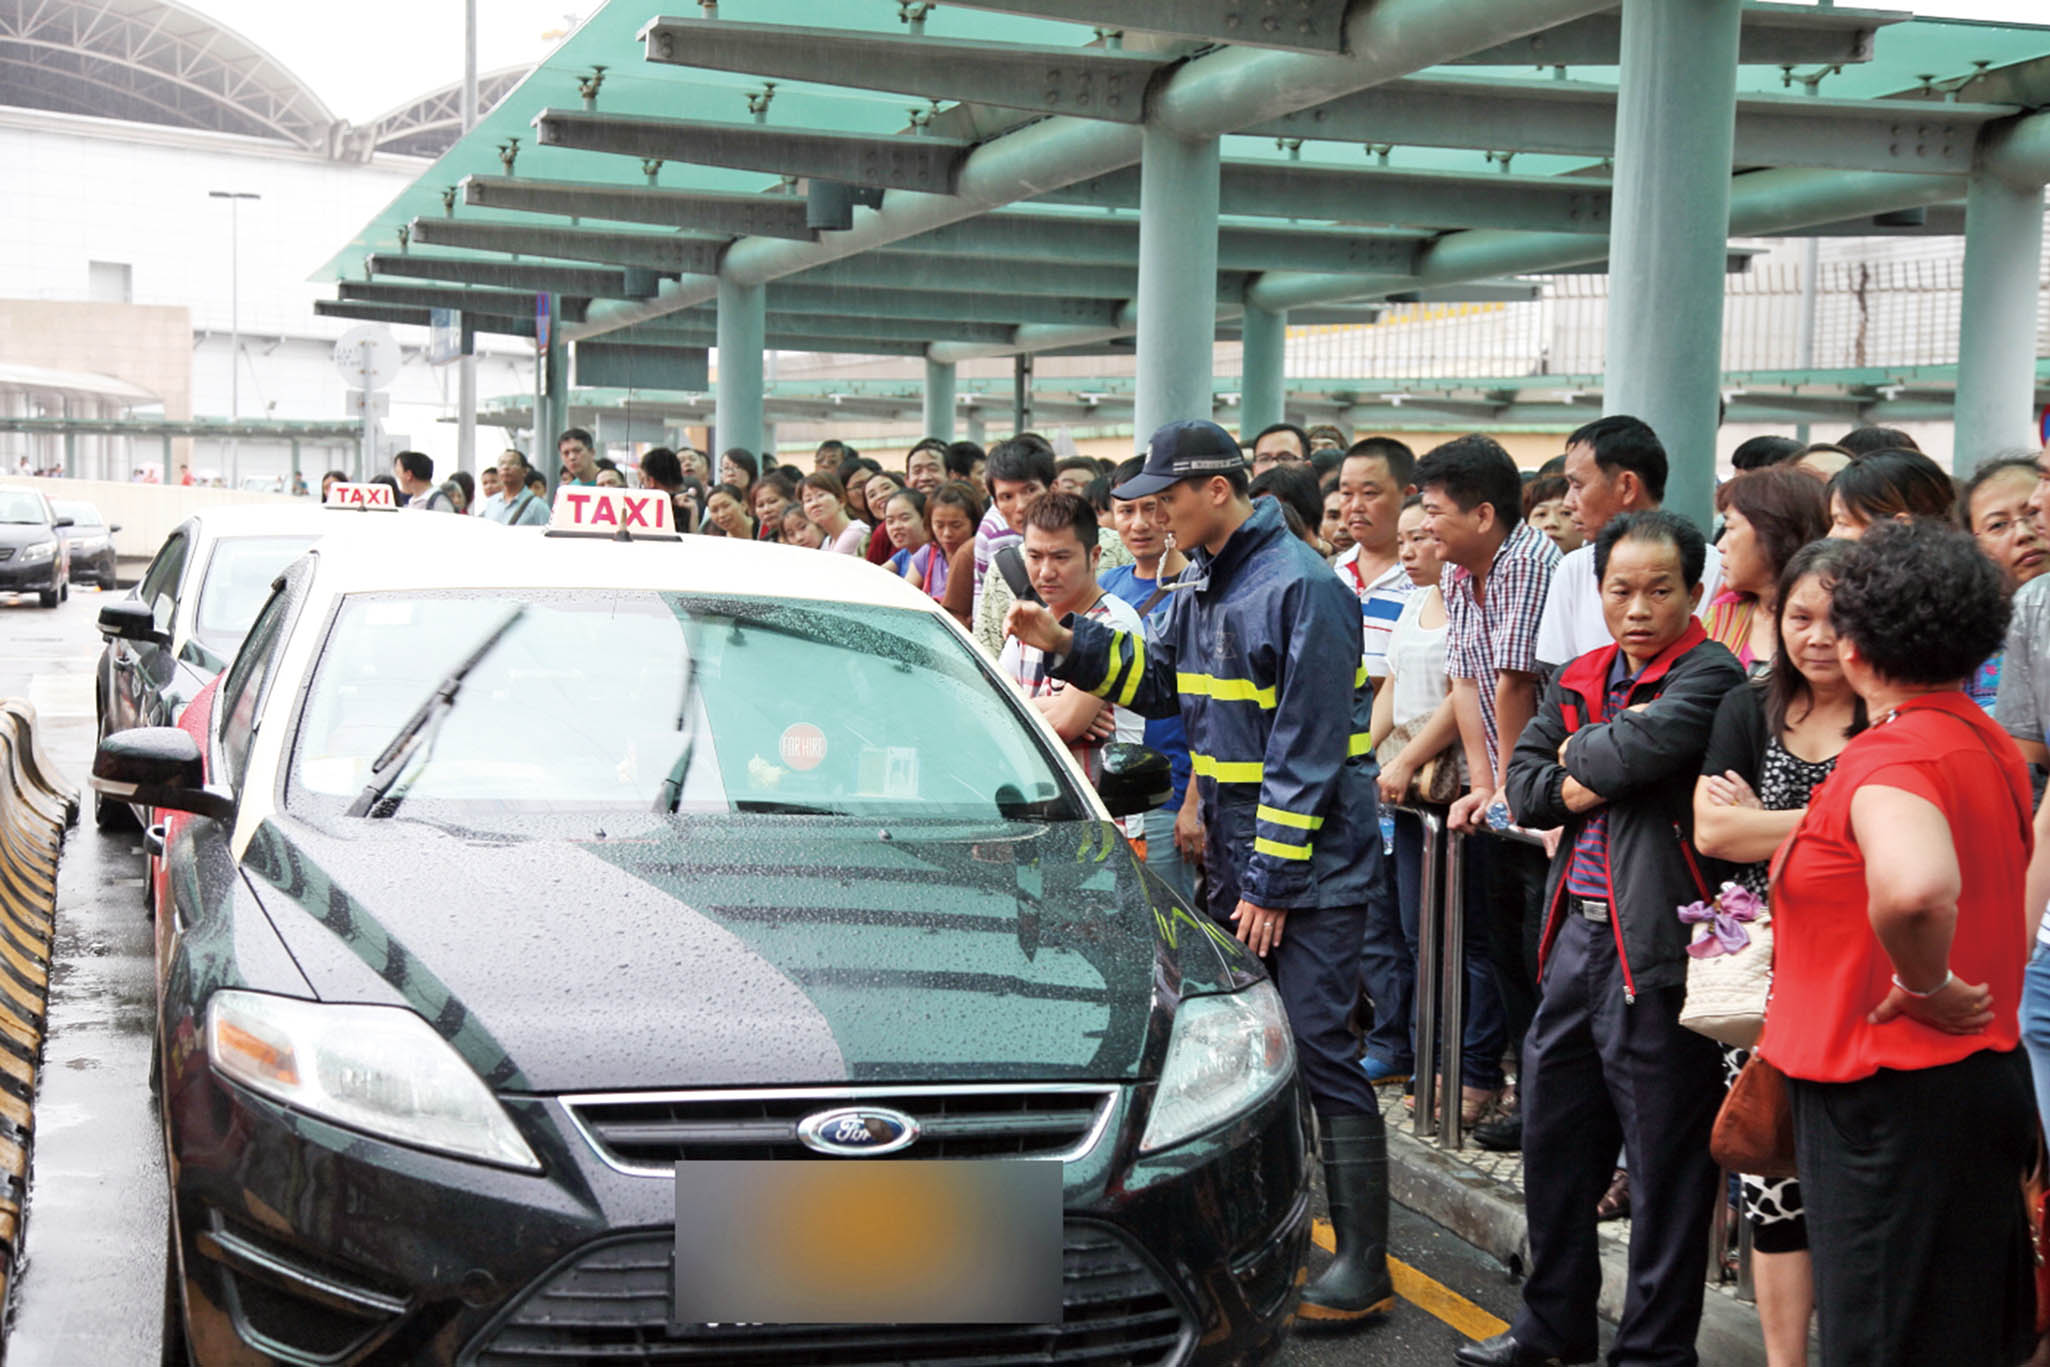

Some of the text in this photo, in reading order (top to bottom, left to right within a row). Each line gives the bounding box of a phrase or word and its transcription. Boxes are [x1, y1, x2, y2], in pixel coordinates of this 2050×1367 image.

[336, 488, 388, 504] TAXI
[567, 494, 664, 528] TAXI
[783, 736, 825, 758] FOR HIRE
[835, 1119, 882, 1141] For
